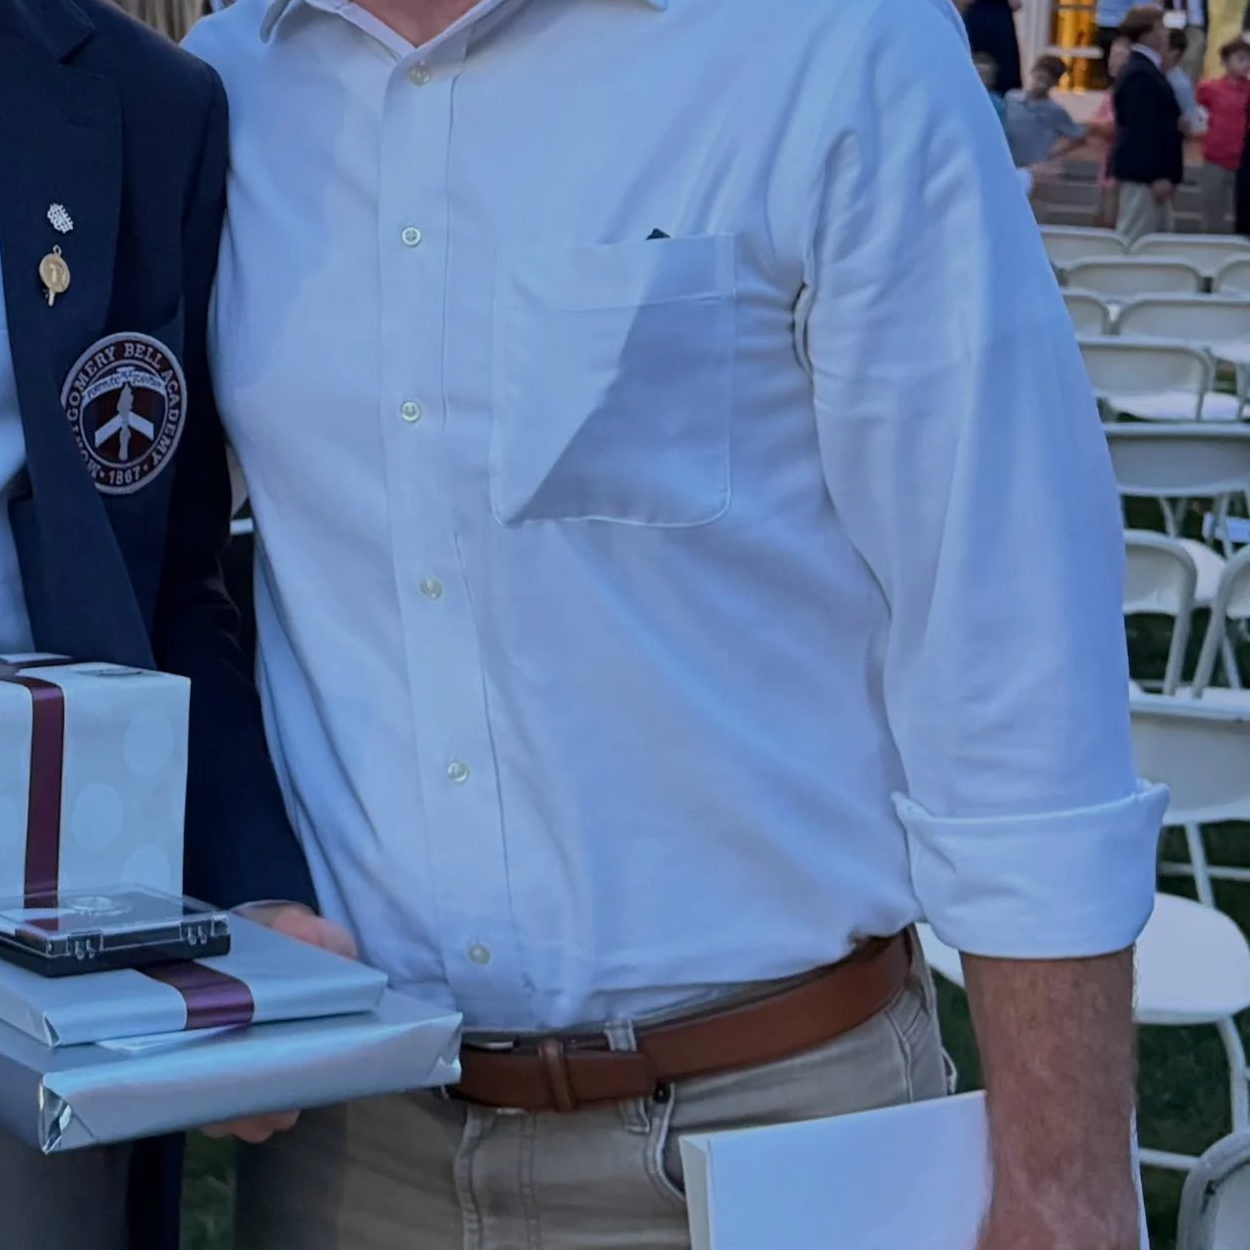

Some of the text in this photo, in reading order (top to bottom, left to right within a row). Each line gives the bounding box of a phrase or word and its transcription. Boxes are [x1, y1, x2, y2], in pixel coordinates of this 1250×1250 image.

[123, 342, 164, 370] BELL
[151, 369, 181, 466] ACADEMY
[108, 464, 141, 485] 1867
